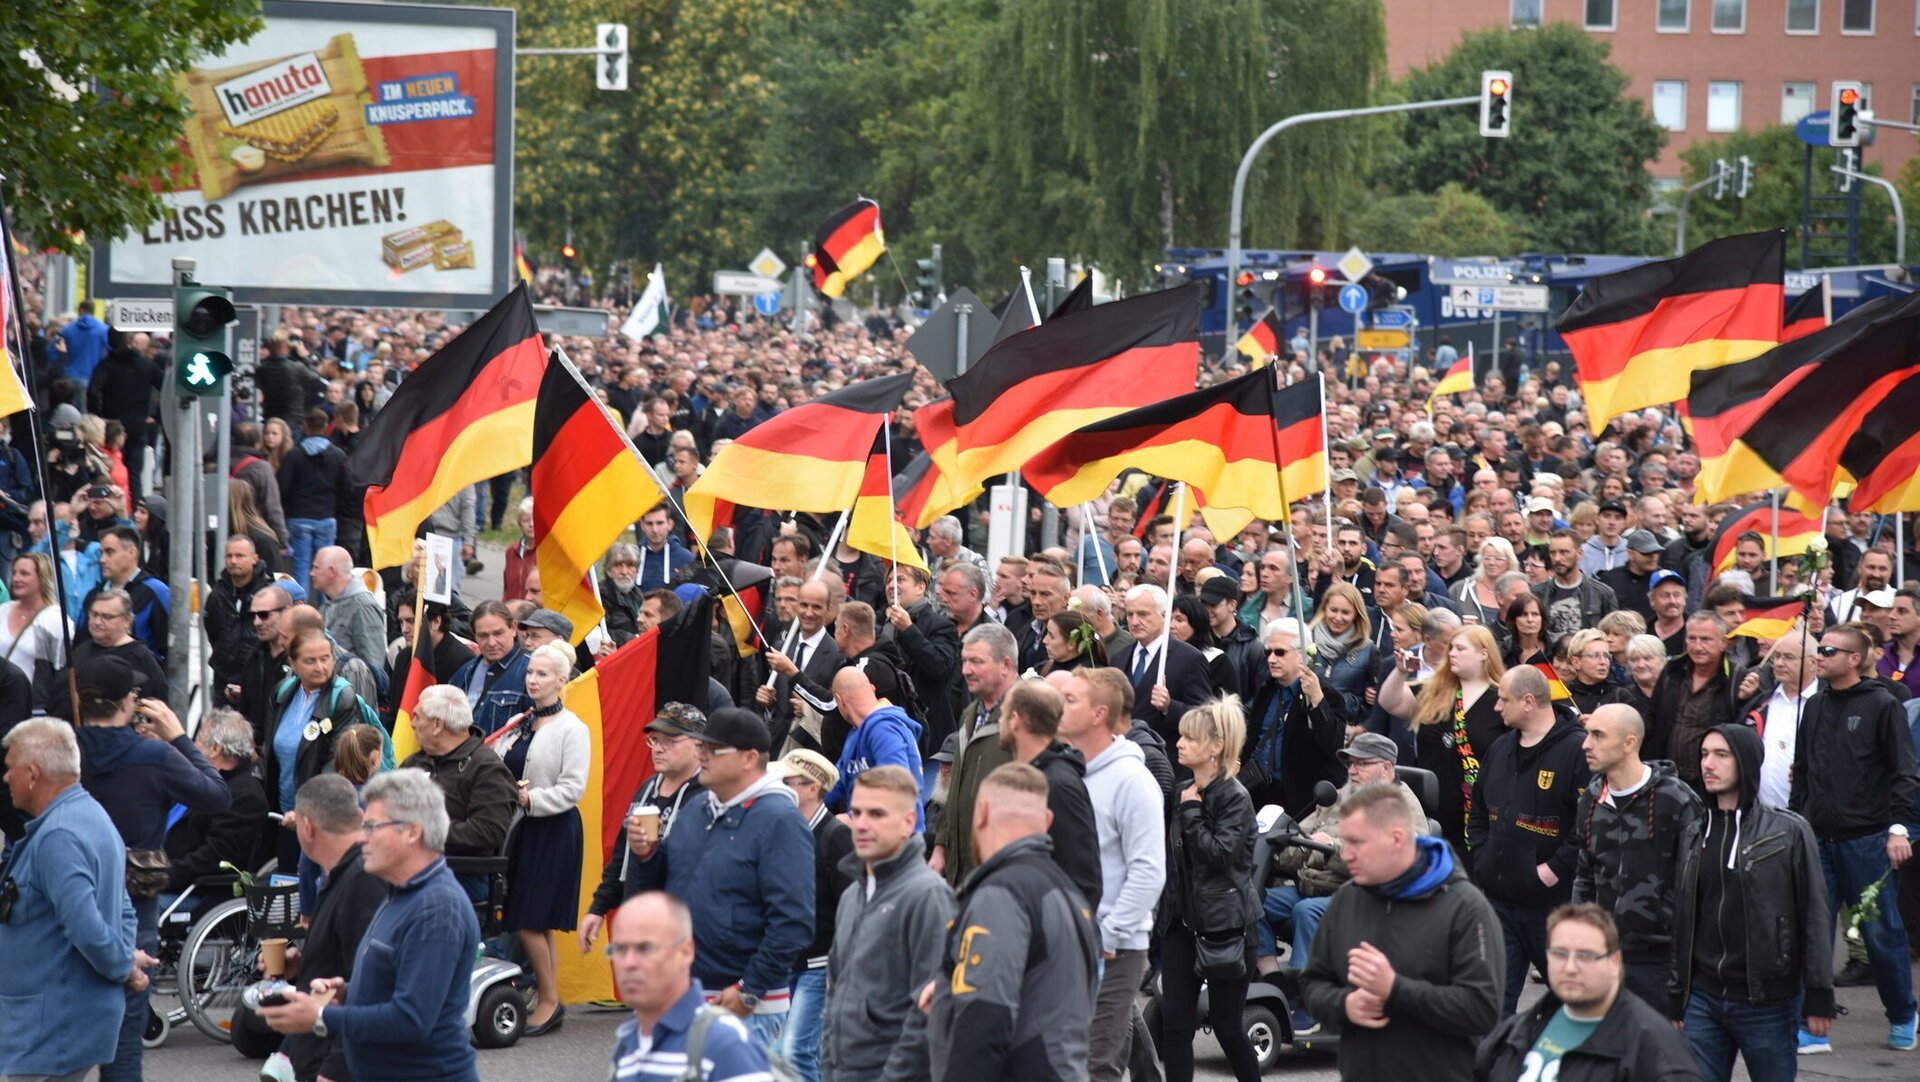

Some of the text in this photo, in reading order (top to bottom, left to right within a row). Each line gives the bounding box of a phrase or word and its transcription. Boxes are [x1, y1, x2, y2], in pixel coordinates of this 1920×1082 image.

[223, 64, 322, 115] hanuta
[381, 77, 454, 101] IM NEUEN
[368, 98, 473, 122] KNUSPERPACK.
[238, 187, 407, 236] KRACHEN!
